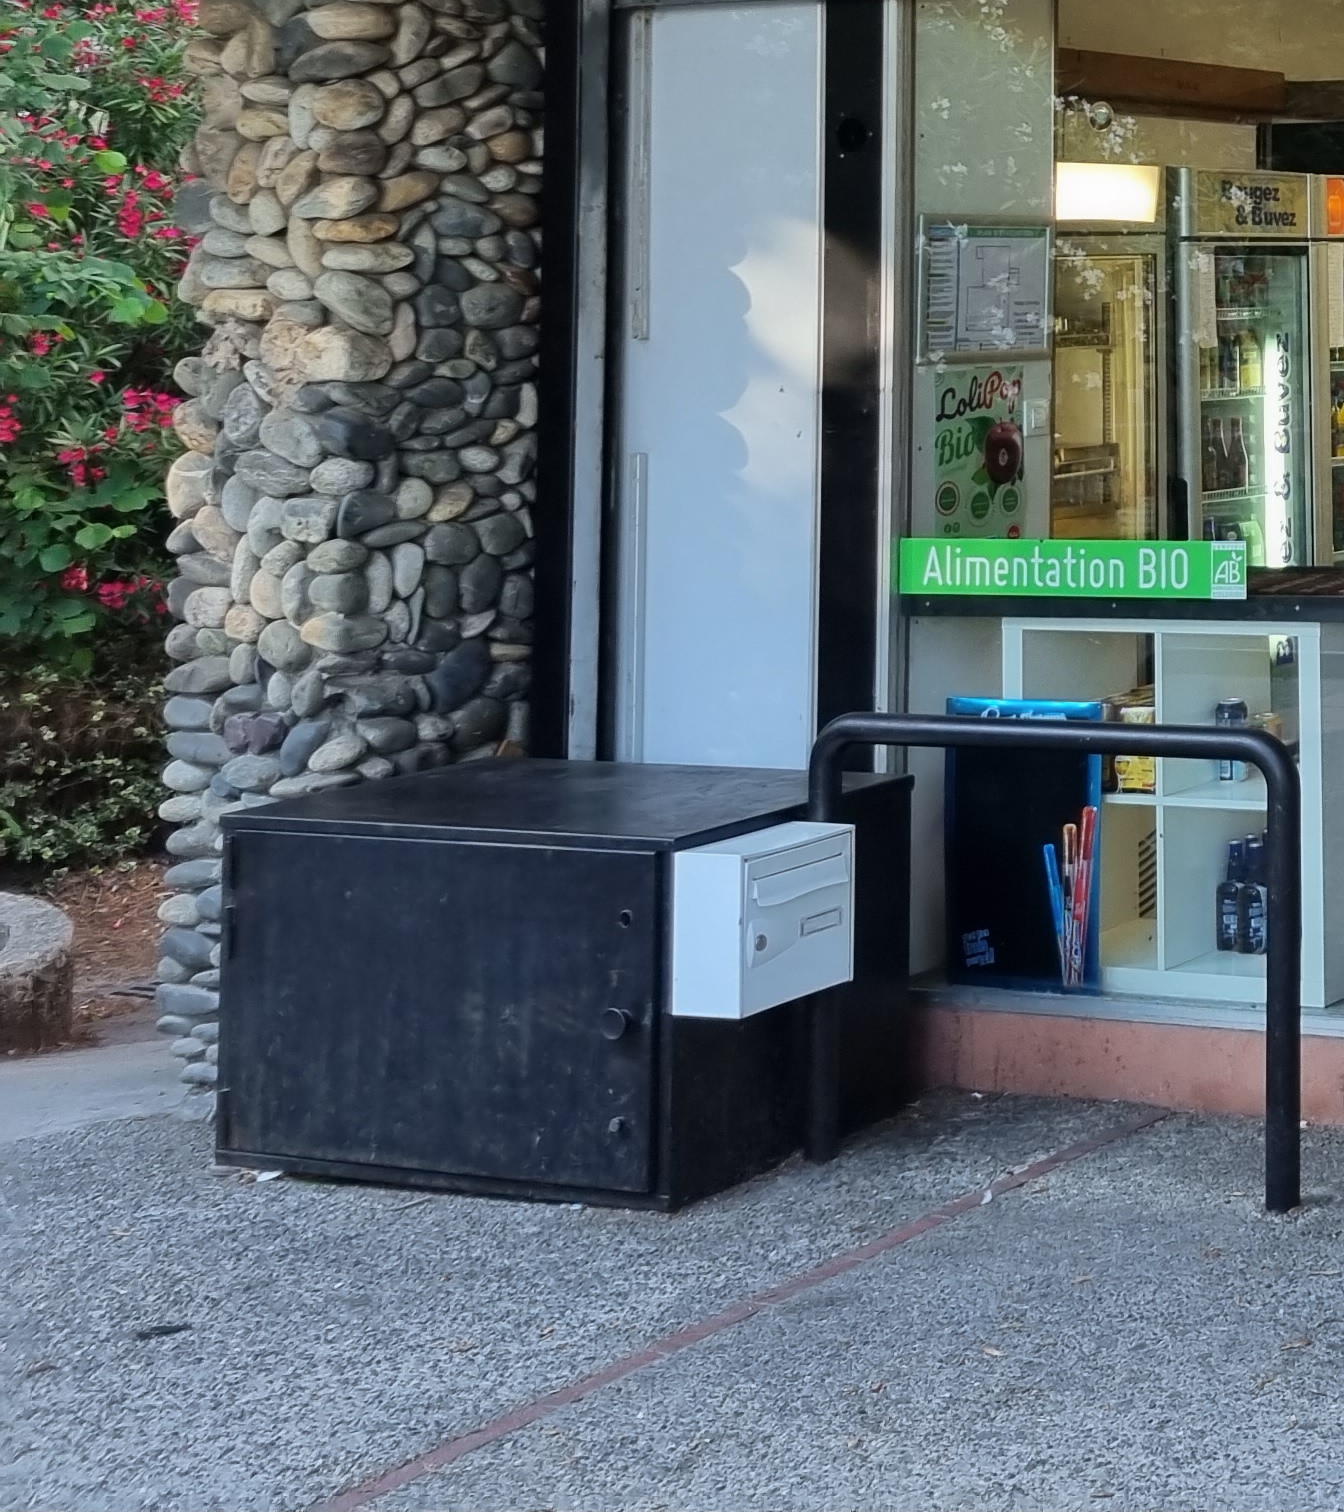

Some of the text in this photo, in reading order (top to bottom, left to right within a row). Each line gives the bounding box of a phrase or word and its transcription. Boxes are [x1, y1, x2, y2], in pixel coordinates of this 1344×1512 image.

[1235, 204, 1297, 227] & Buvez
[923, 545, 1189, 590] Alimentation BIO
[1214, 559, 1241, 584] AB
